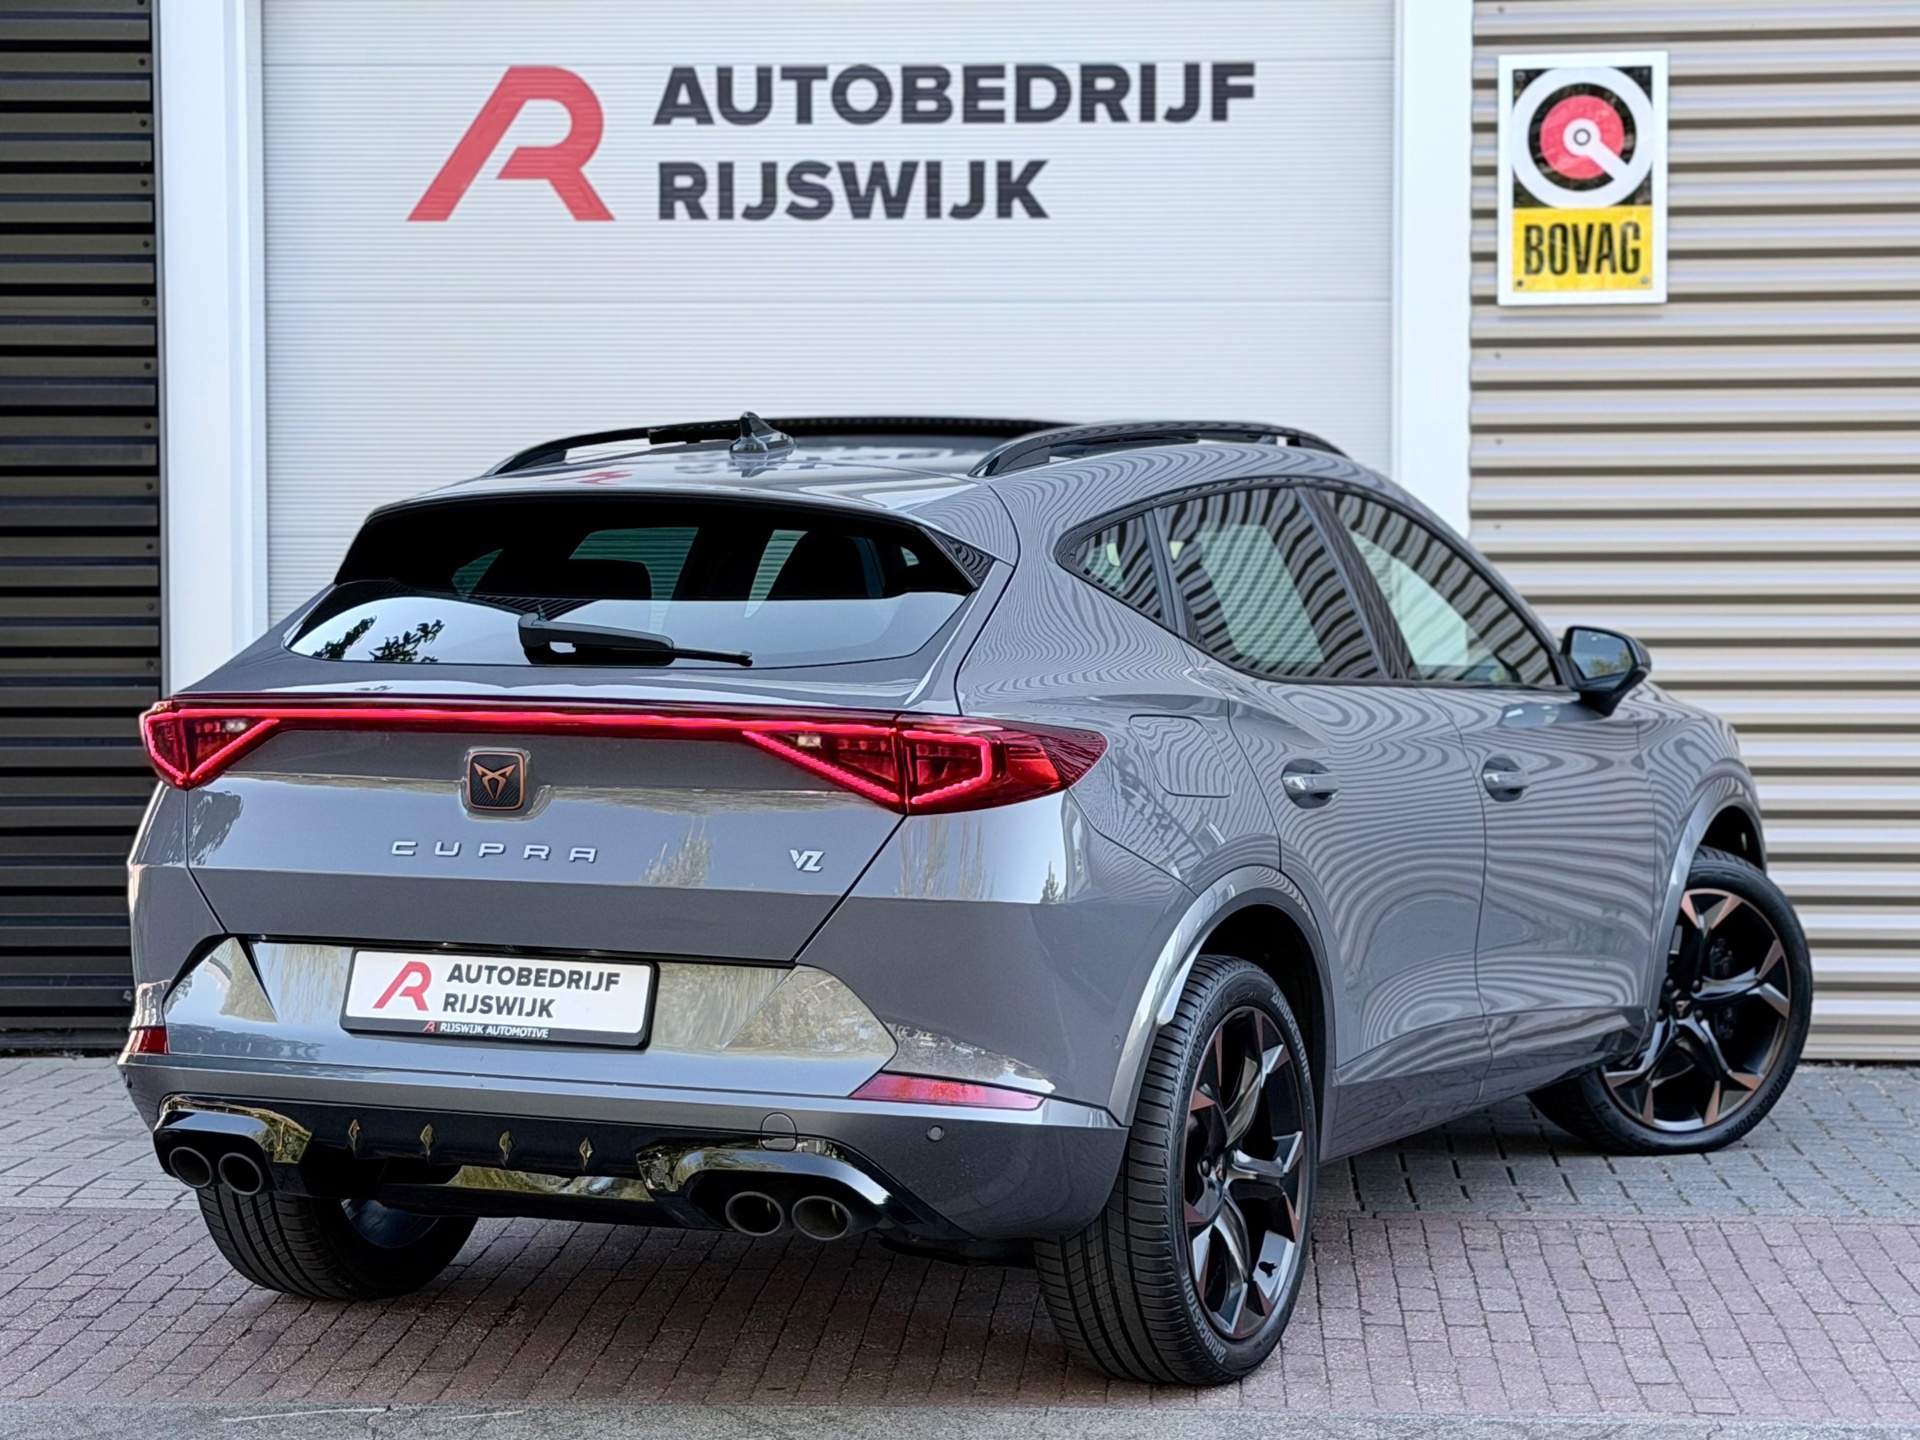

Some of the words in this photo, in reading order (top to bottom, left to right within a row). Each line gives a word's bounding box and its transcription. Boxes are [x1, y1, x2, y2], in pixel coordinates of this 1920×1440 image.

[653, 63, 1256, 125] AUTOBEDRIJF
[658, 160, 1049, 221] RIJSWIJK
[1524, 222, 1641, 276] BOVAG
[391, 841, 597, 863] CUPRA
[790, 849, 824, 872] VZ
[446, 963, 621, 992] AUTOBEDRIJF
[443, 993, 555, 1018] RIJSWIJK
[440, 1022, 484, 1034] RIJSWIJK
[486, 1025, 549, 1039] AUTOMOTIVE
